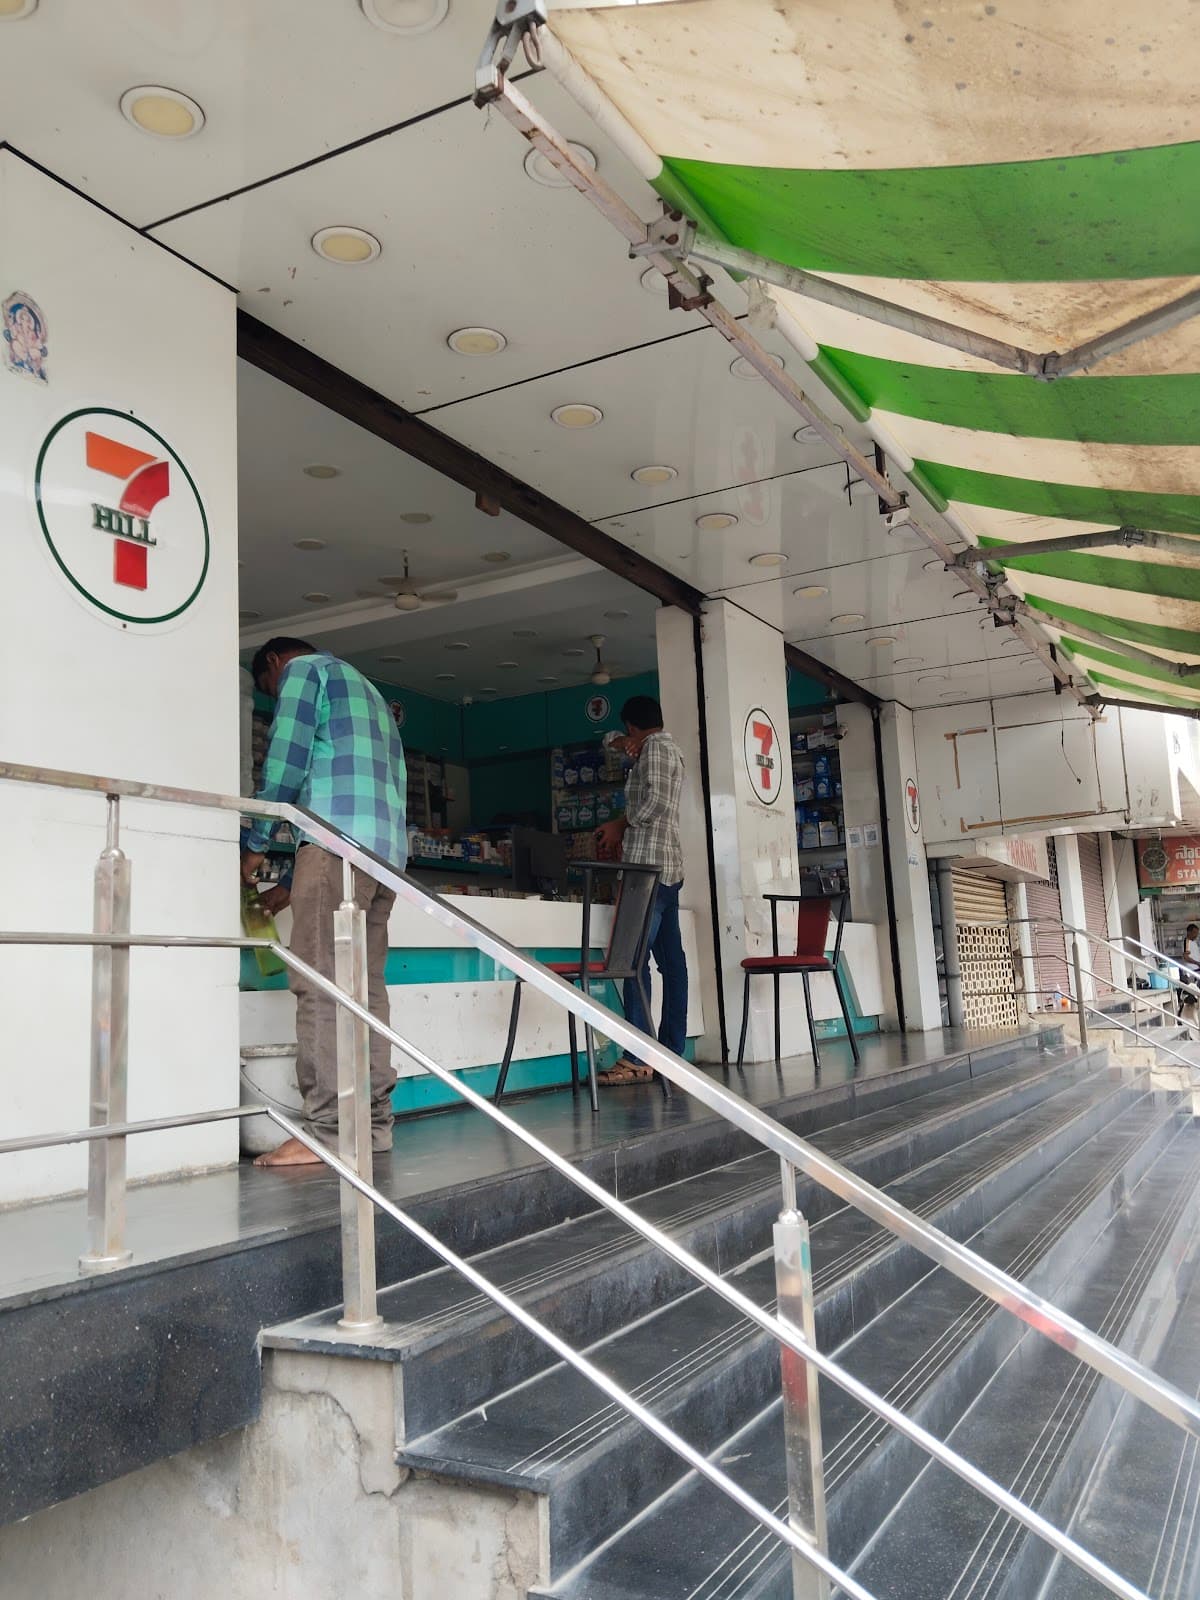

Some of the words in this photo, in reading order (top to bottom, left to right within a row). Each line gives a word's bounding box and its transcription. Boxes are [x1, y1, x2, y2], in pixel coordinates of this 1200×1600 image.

[85, 431, 169, 591] 7
[91, 502, 157, 546] HILL
[752, 720, 773, 790] 7
